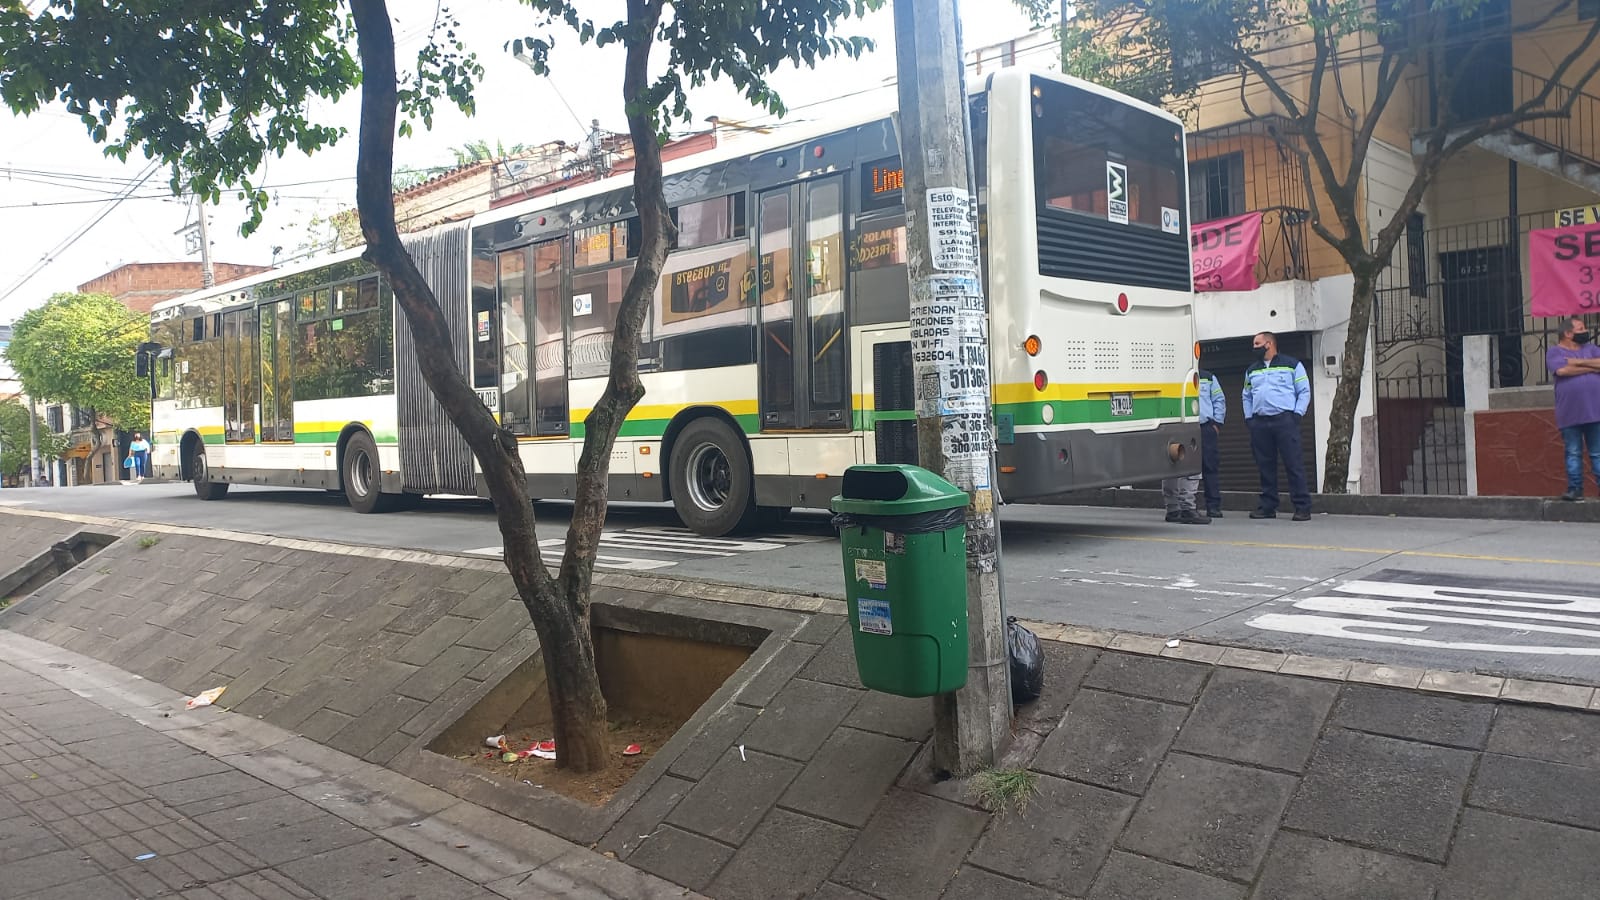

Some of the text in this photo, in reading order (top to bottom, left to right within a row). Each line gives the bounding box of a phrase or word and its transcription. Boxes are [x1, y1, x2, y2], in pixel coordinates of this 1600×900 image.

[1559, 208, 1585, 227] SE
[921, 339, 944, 349] WI-FI
[951, 443, 969, 453] 300
